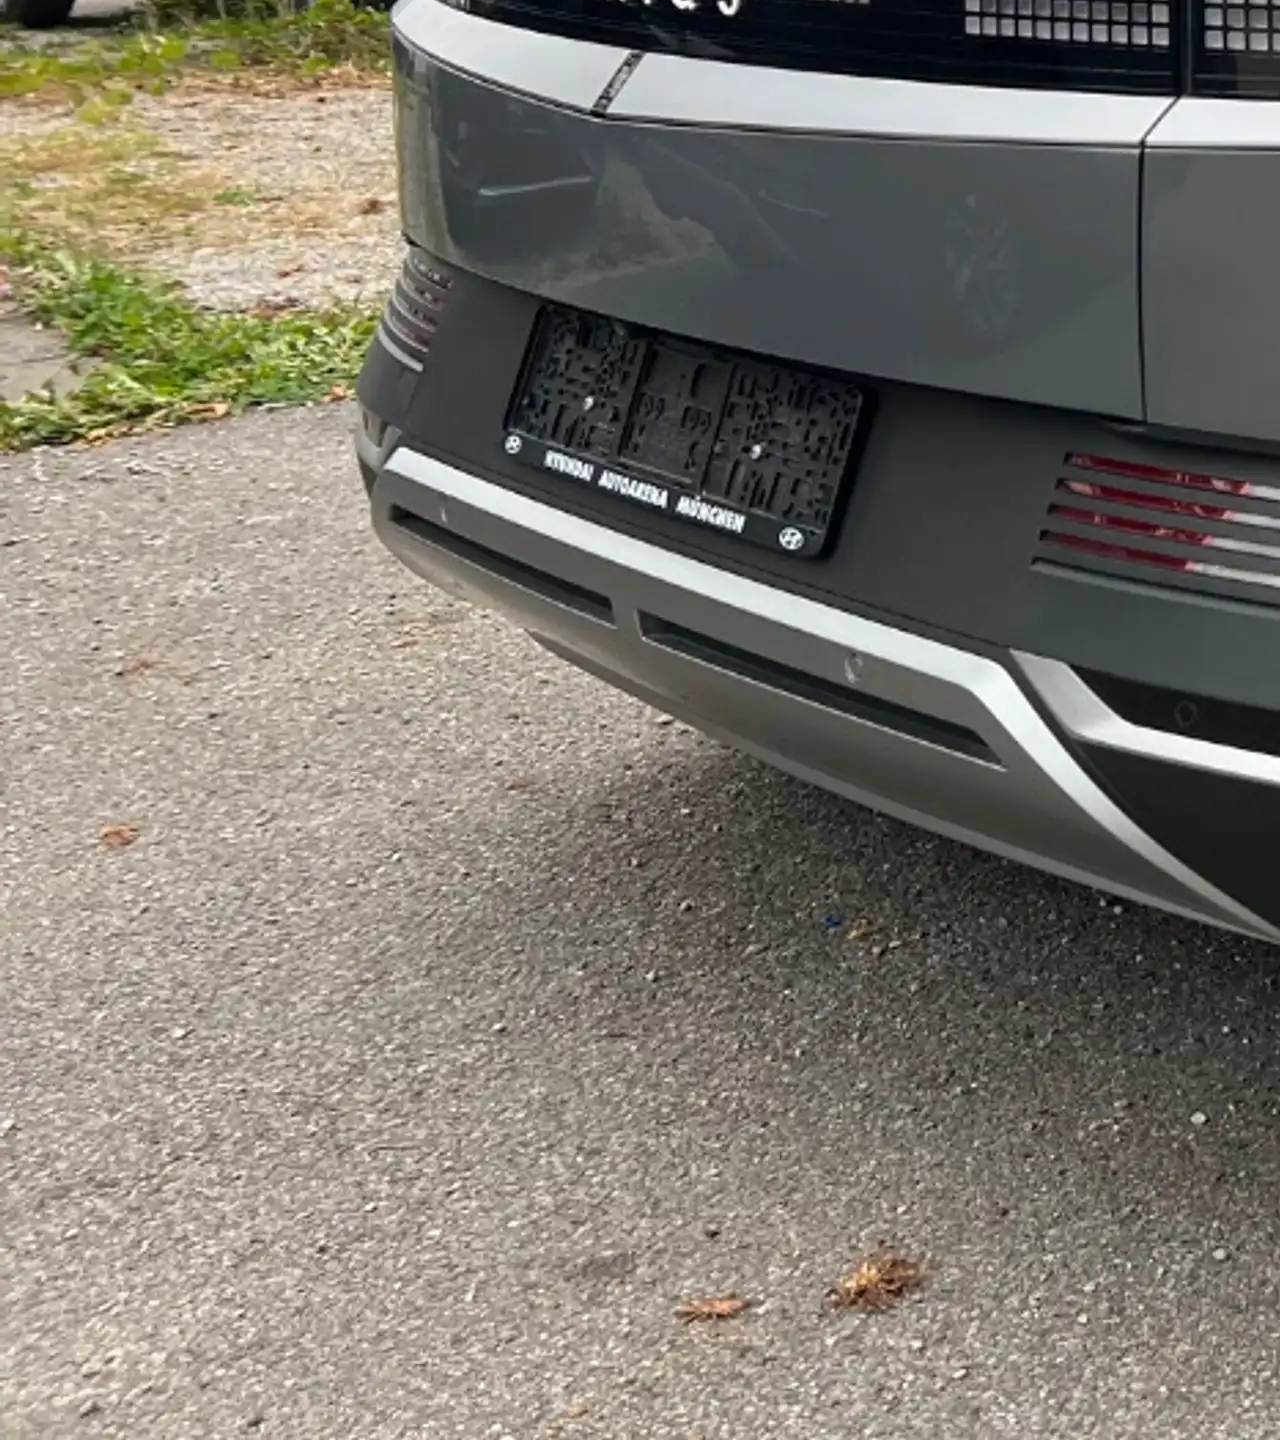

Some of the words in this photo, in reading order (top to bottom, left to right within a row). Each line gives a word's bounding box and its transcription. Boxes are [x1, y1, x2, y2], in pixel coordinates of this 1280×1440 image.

[543, 449, 595, 483] HYUNDAI
[597, 468, 669, 510] AUTOARENA
[674, 490, 747, 535] MÜNCHEN
